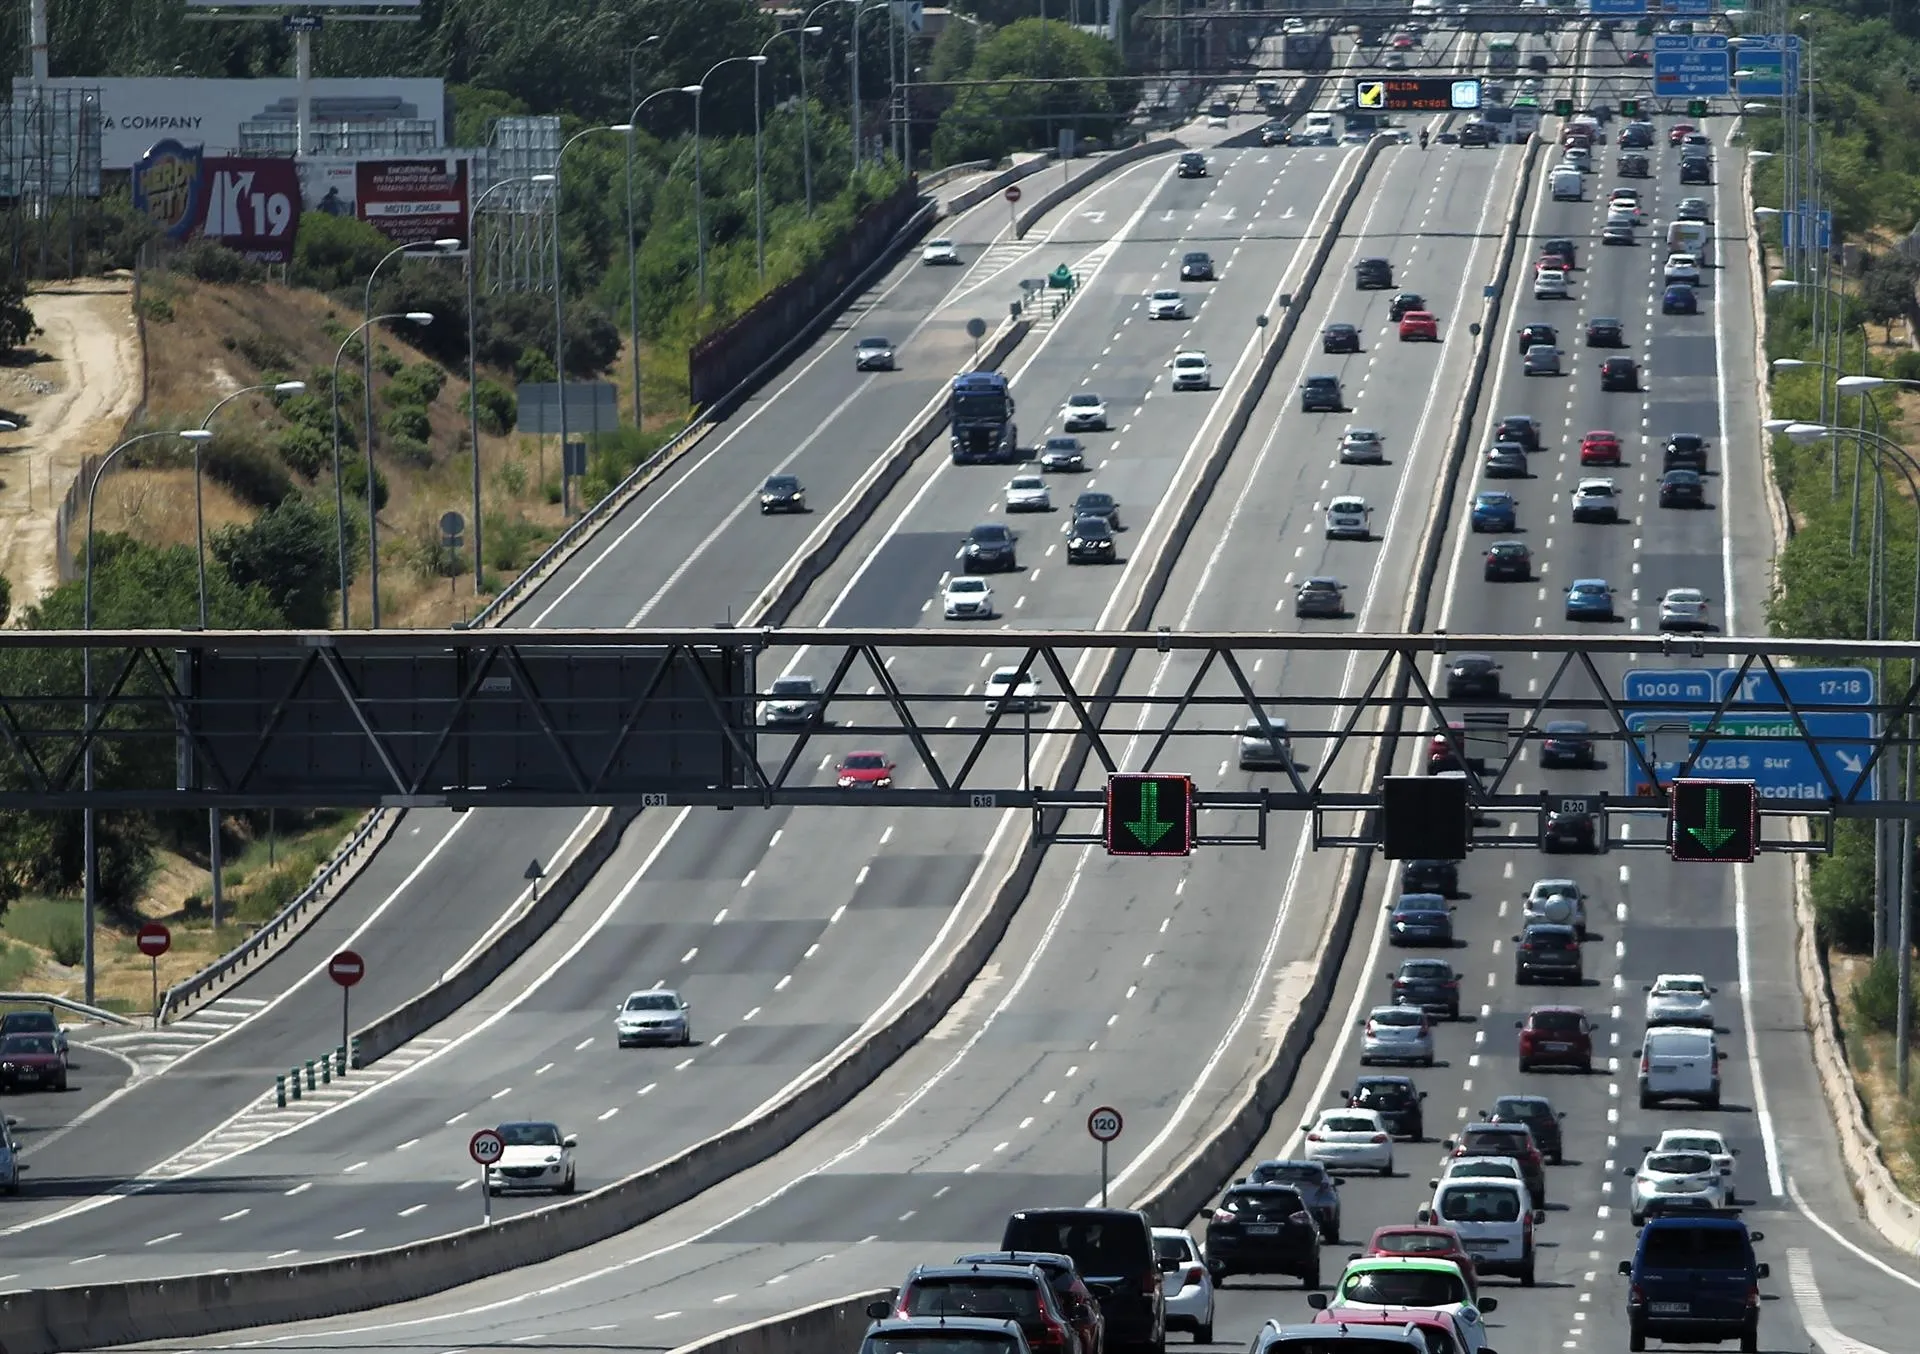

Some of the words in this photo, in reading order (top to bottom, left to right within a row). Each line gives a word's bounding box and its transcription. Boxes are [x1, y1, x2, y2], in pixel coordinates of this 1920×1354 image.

[121, 115, 202, 129] COMPANY
[251, 192, 291, 237] 19
[1637, 683, 1680, 696] 1000
[1686, 684, 1702, 696] m
[1819, 680, 1861, 695] 17-18
[1763, 756, 1791, 769] sur
[1755, 782, 1824, 799] corial
[1094, 1118, 1116, 1130] 120
[476, 1141, 499, 1154] 120
